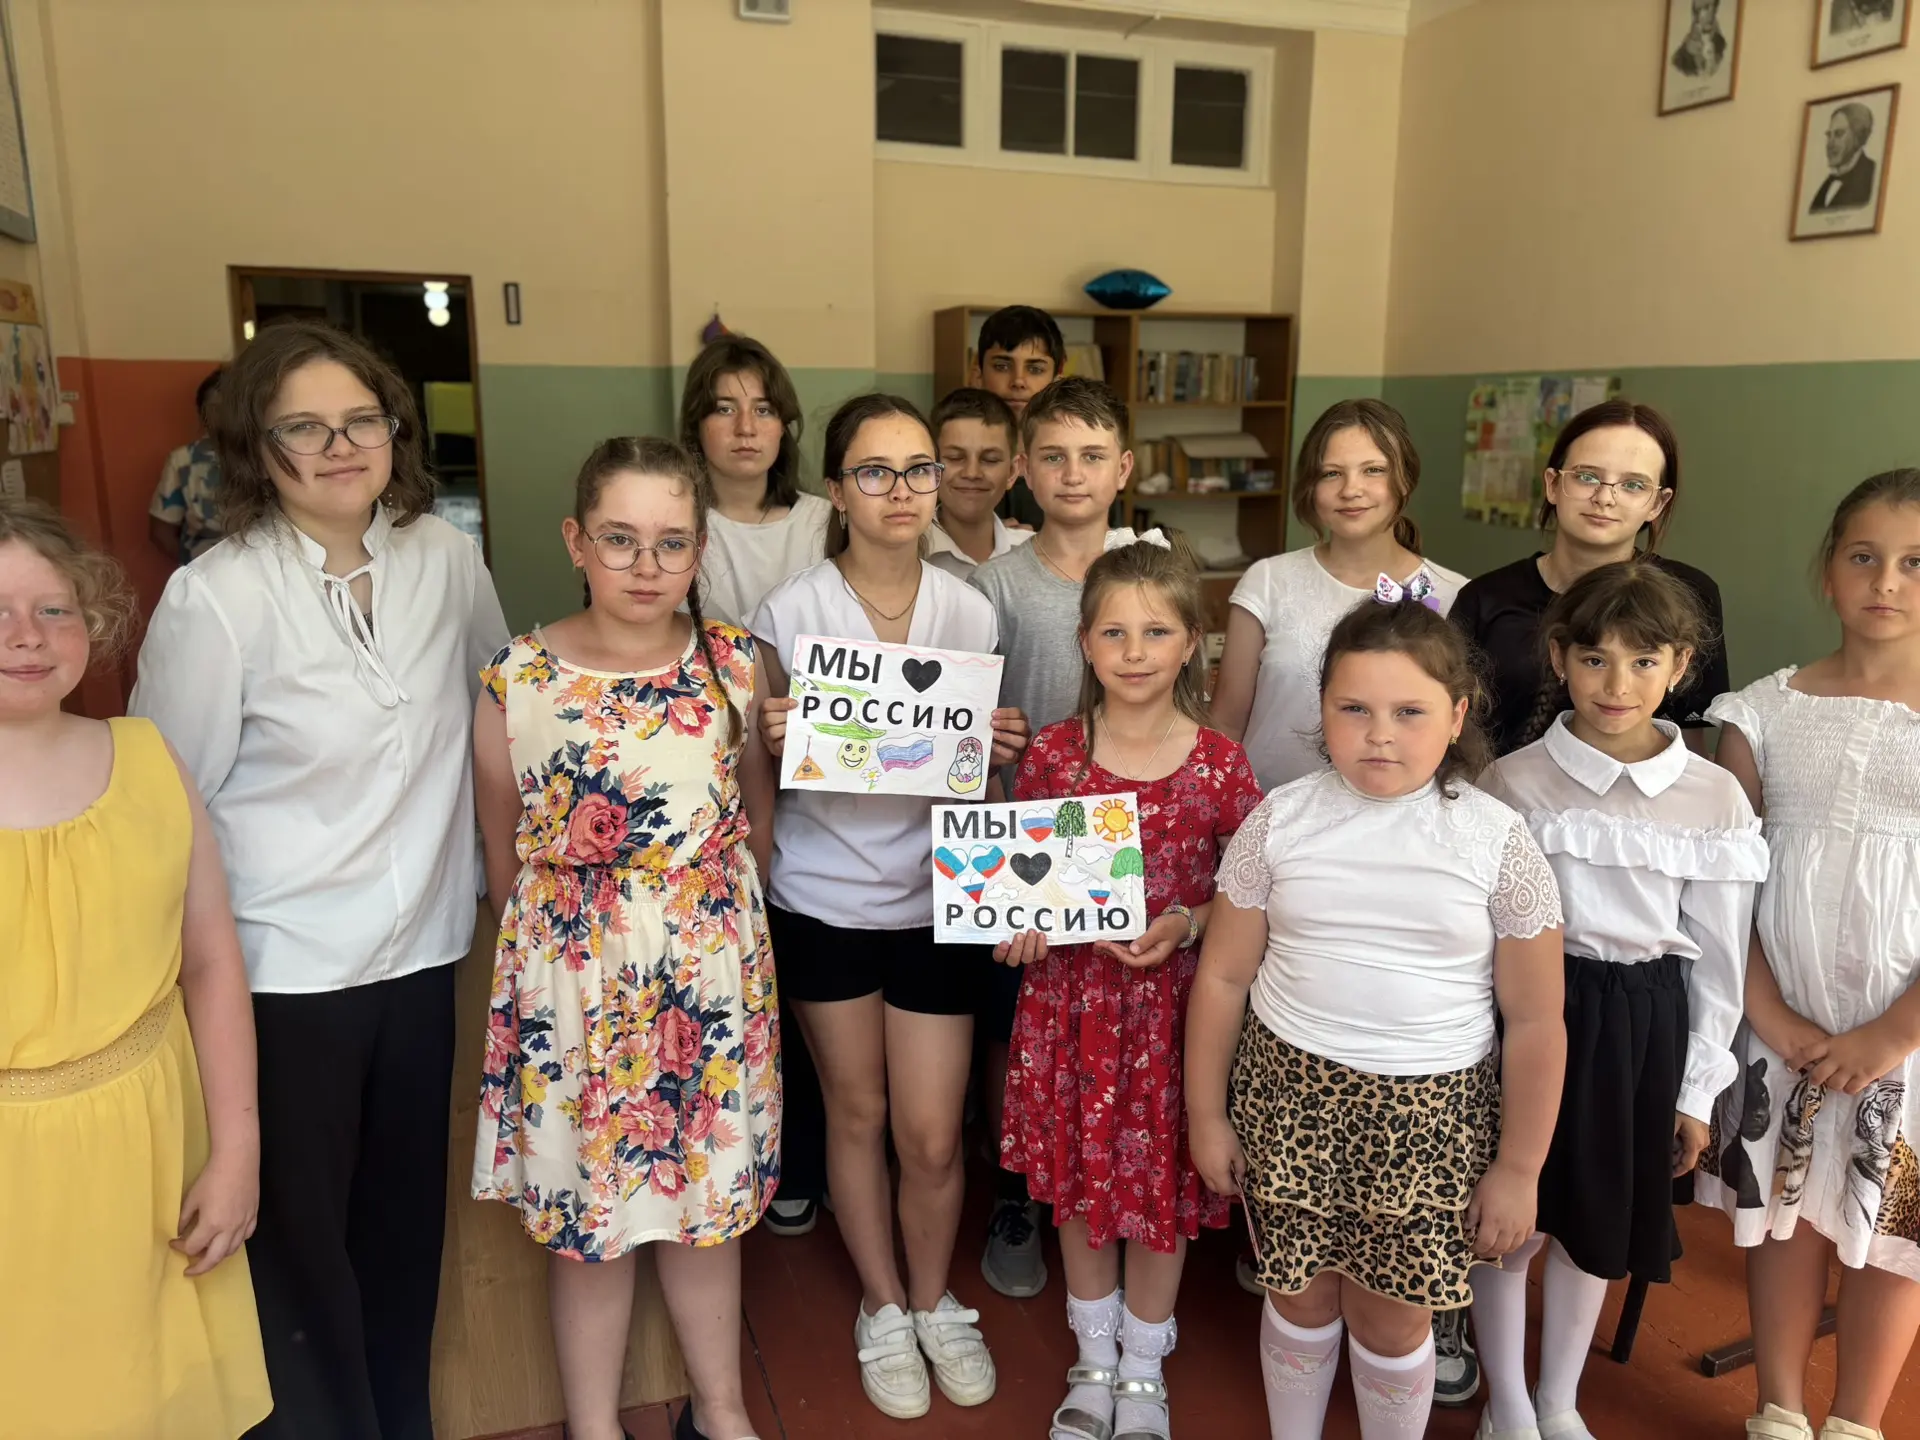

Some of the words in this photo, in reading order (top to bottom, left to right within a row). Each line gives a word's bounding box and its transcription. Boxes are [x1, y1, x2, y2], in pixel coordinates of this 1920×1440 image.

[807, 643, 883, 684] МЫ
[802, 695, 974, 731] РОССИЮ
[942, 810, 1017, 839] МЫ
[945, 903, 1130, 931] РОССИЮ
